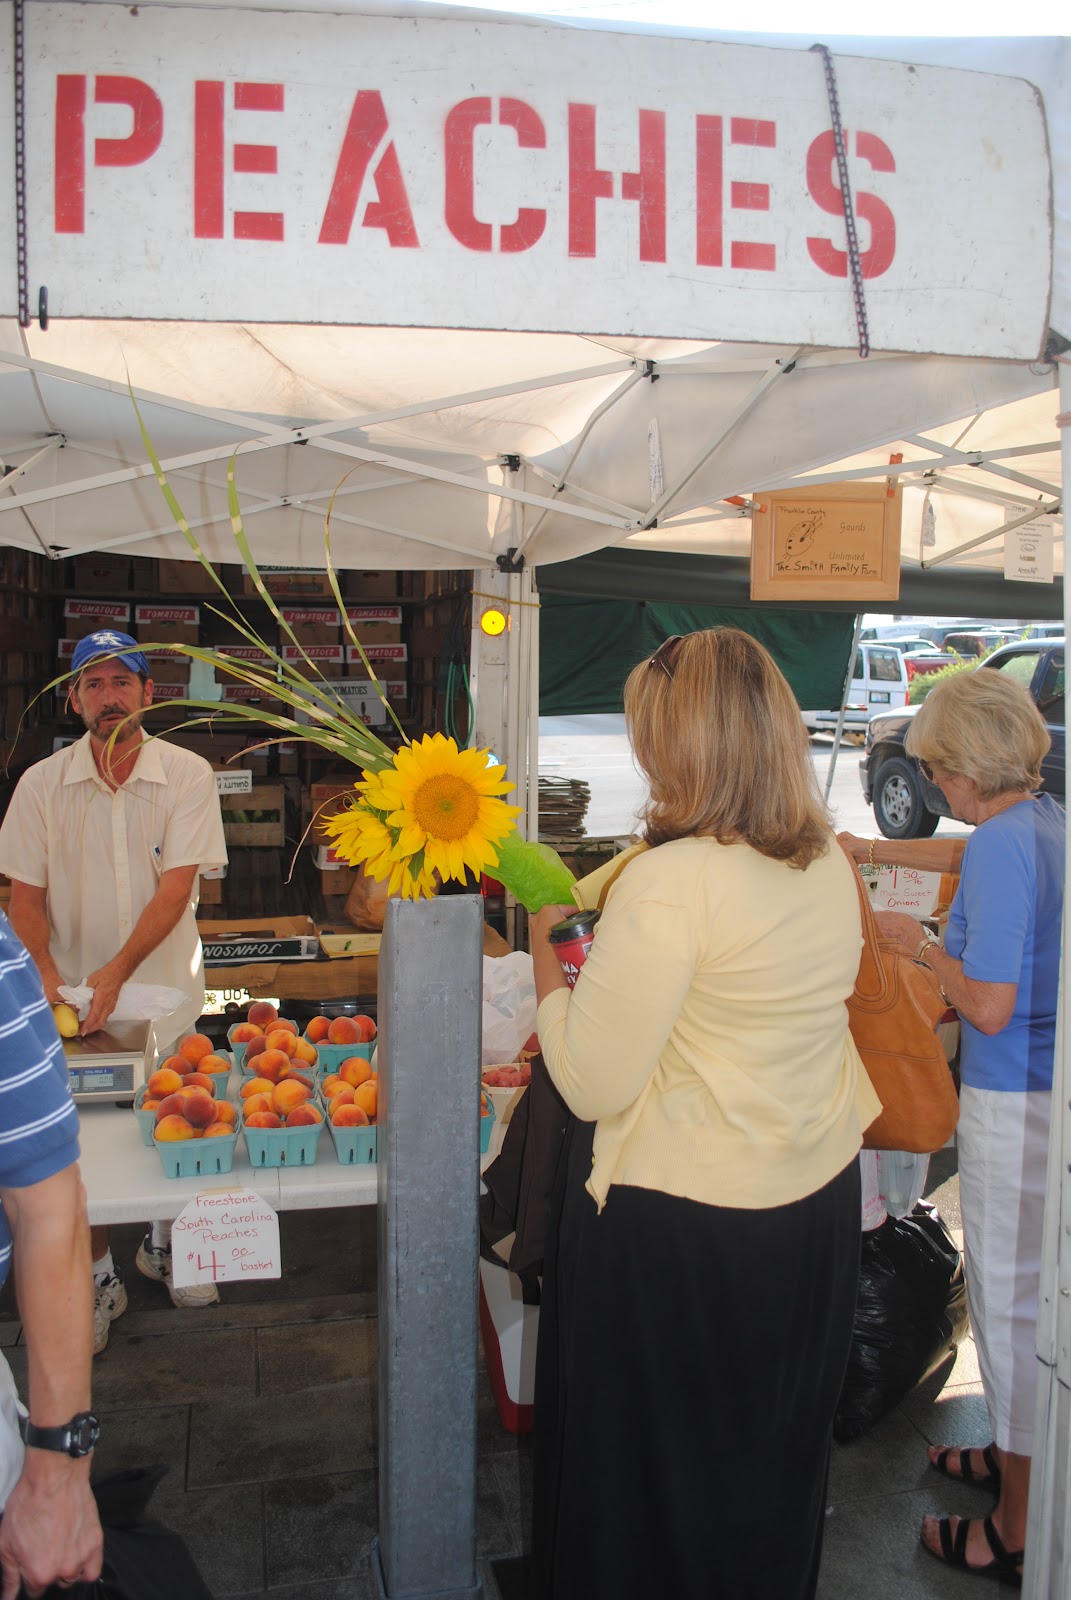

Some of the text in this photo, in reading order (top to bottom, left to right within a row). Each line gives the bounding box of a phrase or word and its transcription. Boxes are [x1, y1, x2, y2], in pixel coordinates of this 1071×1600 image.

[54, 73, 897, 279] PEACHES
[840, 522, 866, 534] Gourds
[829, 552, 866, 561] Unlimited
[776, 561, 791, 572] The
[76, 604, 120, 615] TOMATOES
[146, 610, 190, 619] TOMATOES
[352, 609, 394, 618] TOMATOES
[290, 612, 332, 621] TOMATOES
[223, 780, 249, 790] QUALITY
[903, 888, 933, 897] Sweet
[887, 898, 920, 908] Onions
[203, 943, 282, 957] JOHNSON
[196, 1194, 259, 1208] Freestone
[175, 1210, 274, 1231] South Carolina
[192, 1228, 259, 1244] Peaches
[240, 1259, 274, 1272] basket
